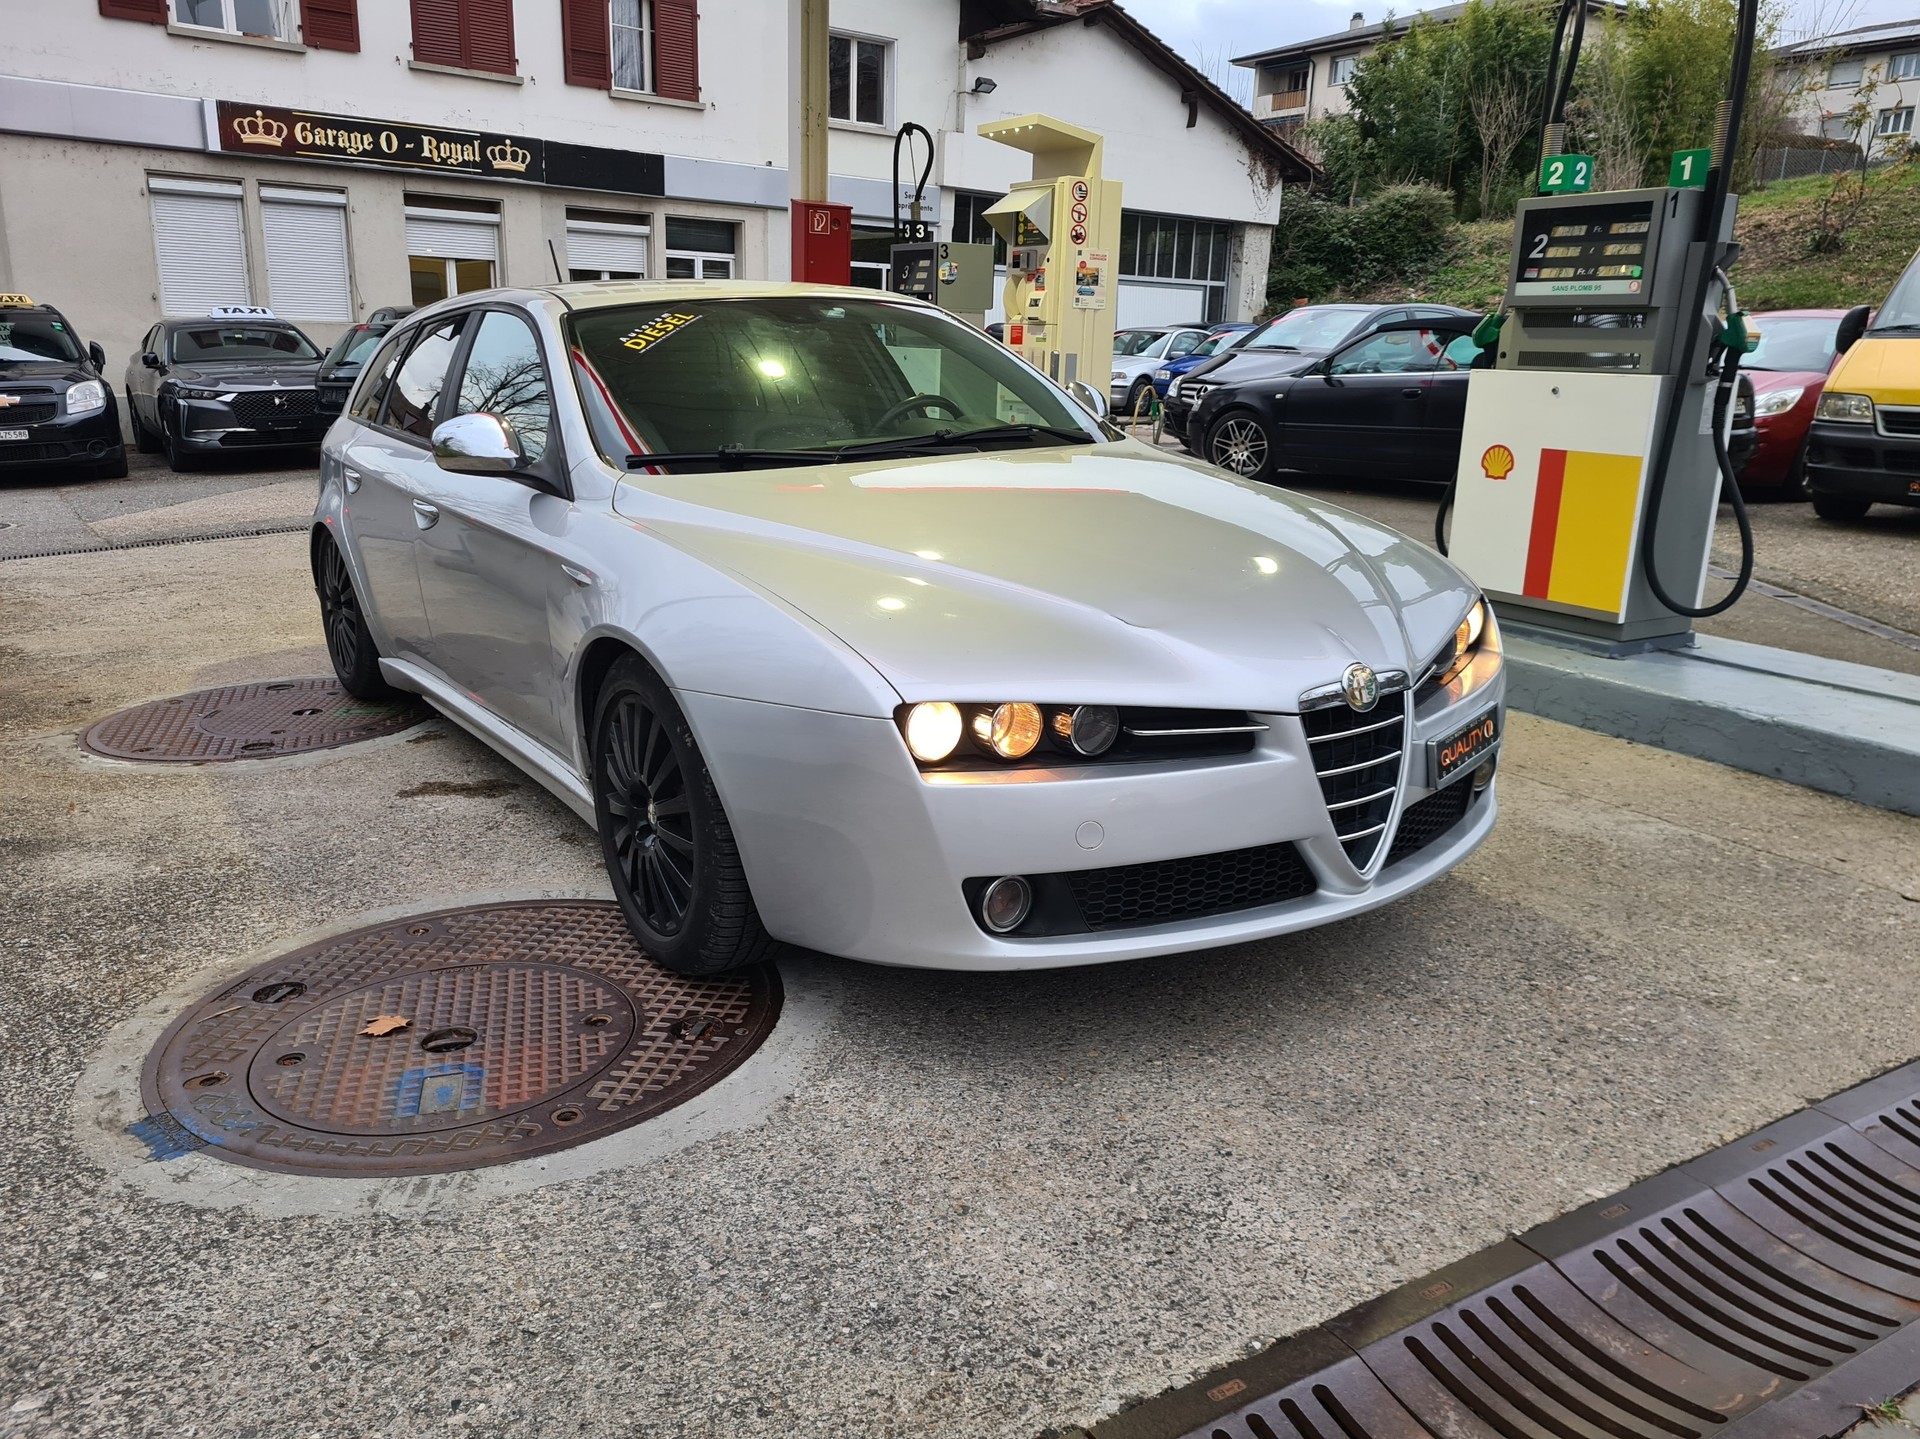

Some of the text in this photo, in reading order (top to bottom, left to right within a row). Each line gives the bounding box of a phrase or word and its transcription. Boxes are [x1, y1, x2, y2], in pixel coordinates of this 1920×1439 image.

[294, 121, 373, 155] Garage
[379, 130, 399, 155] O
[421, 134, 482, 165] Royal
[1547, 161, 1565, 186] 2
[1574, 161, 1587, 186] 2
[1680, 155, 1694, 181] 1
[904, 190, 927, 201] Serce
[1670, 191, 1680, 219] 1
[904, 224, 911, 238] 3
[915, 224, 925, 238] 3
[940, 243, 949, 259] 3
[1528, 233, 1549, 259] 2
[902, 265, 910, 279] 3
[1569, 284, 1593, 292] PLOMB
[0, 295, 26, 303] AXI
[218, 307, 268, 315] TAXI
[623, 313, 695, 350] DIESEL
[1441, 725, 1484, 767] QUALITY
